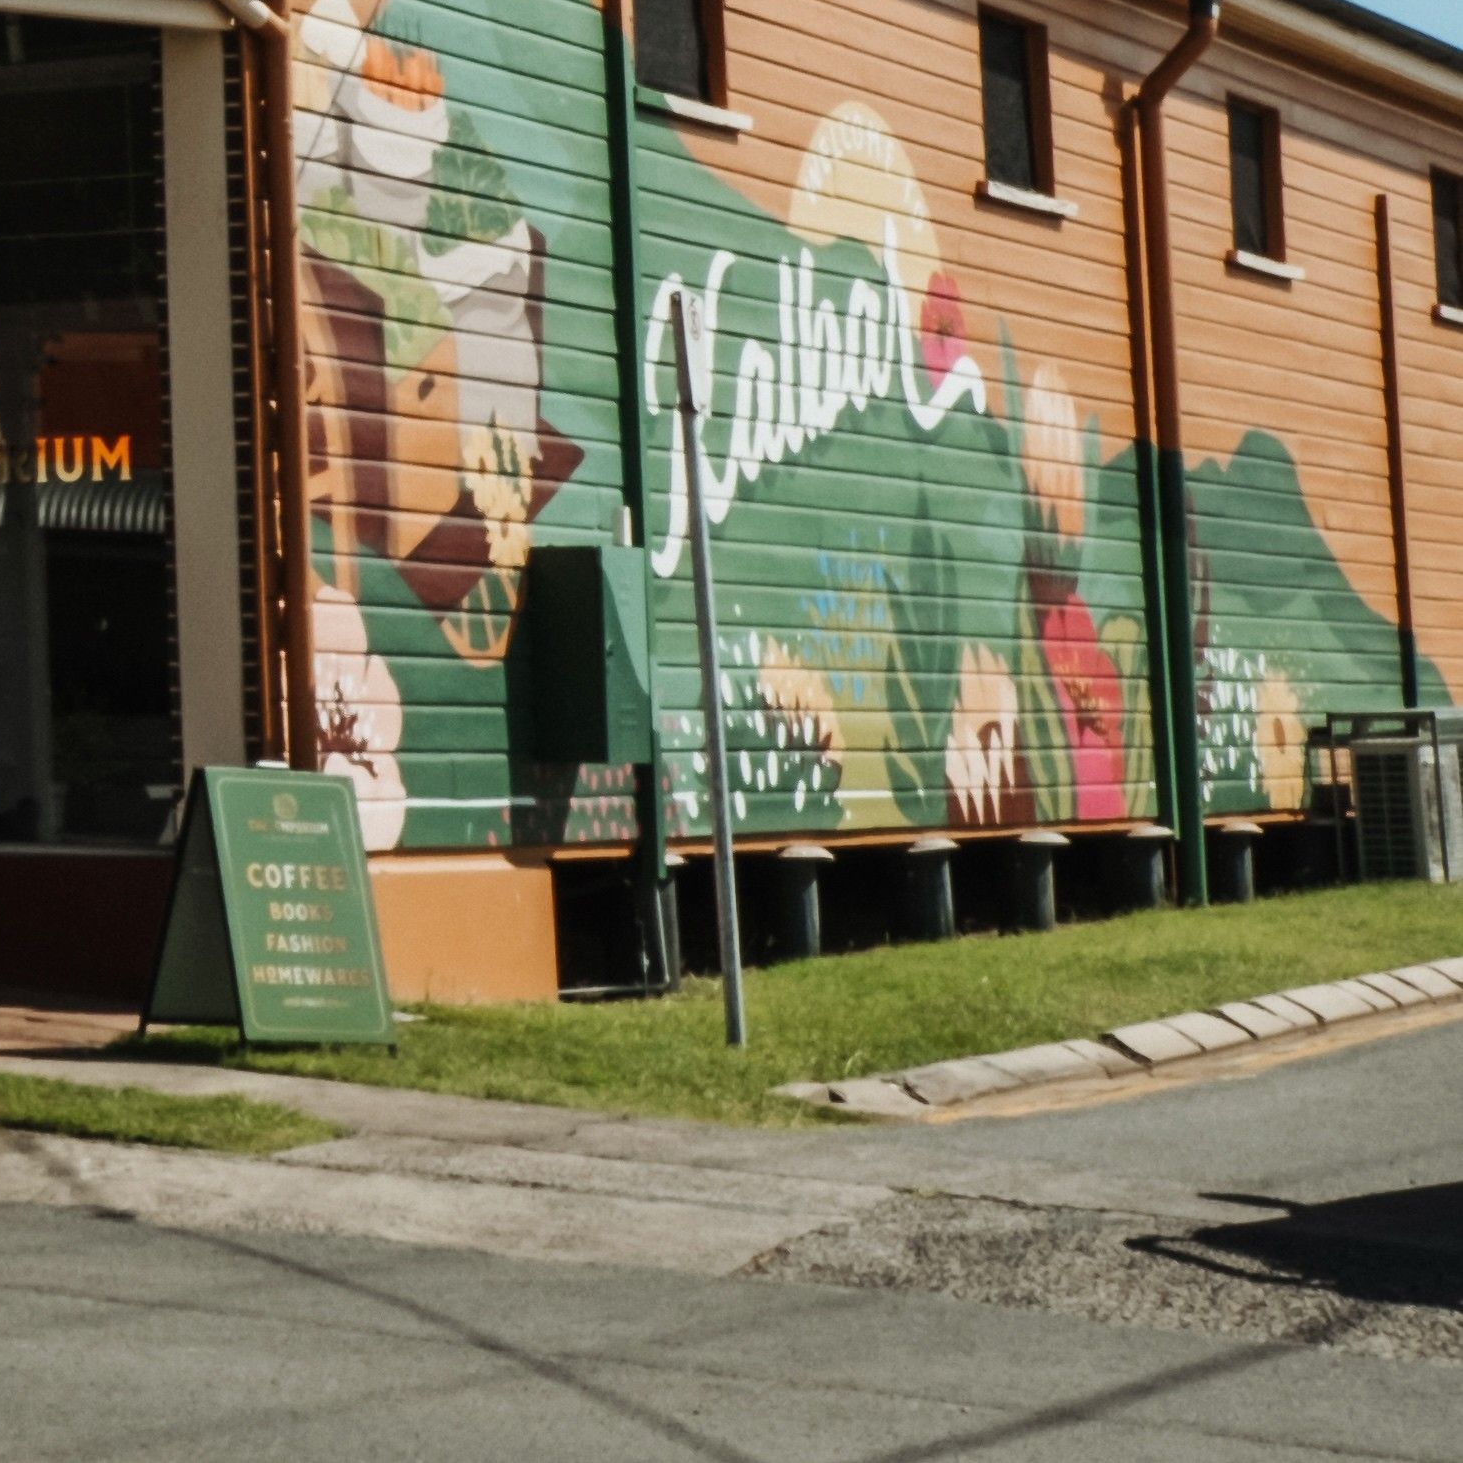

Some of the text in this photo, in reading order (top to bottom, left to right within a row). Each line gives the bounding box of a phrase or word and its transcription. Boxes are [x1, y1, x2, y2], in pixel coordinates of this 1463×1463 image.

[644, 213, 987, 578] Kalbar
[246, 862, 347, 890] COFFEE
[269, 901, 333, 922] BOOKS
[266, 932, 348, 954] FASHION
[252, 965, 372, 988] HOMEWARES
